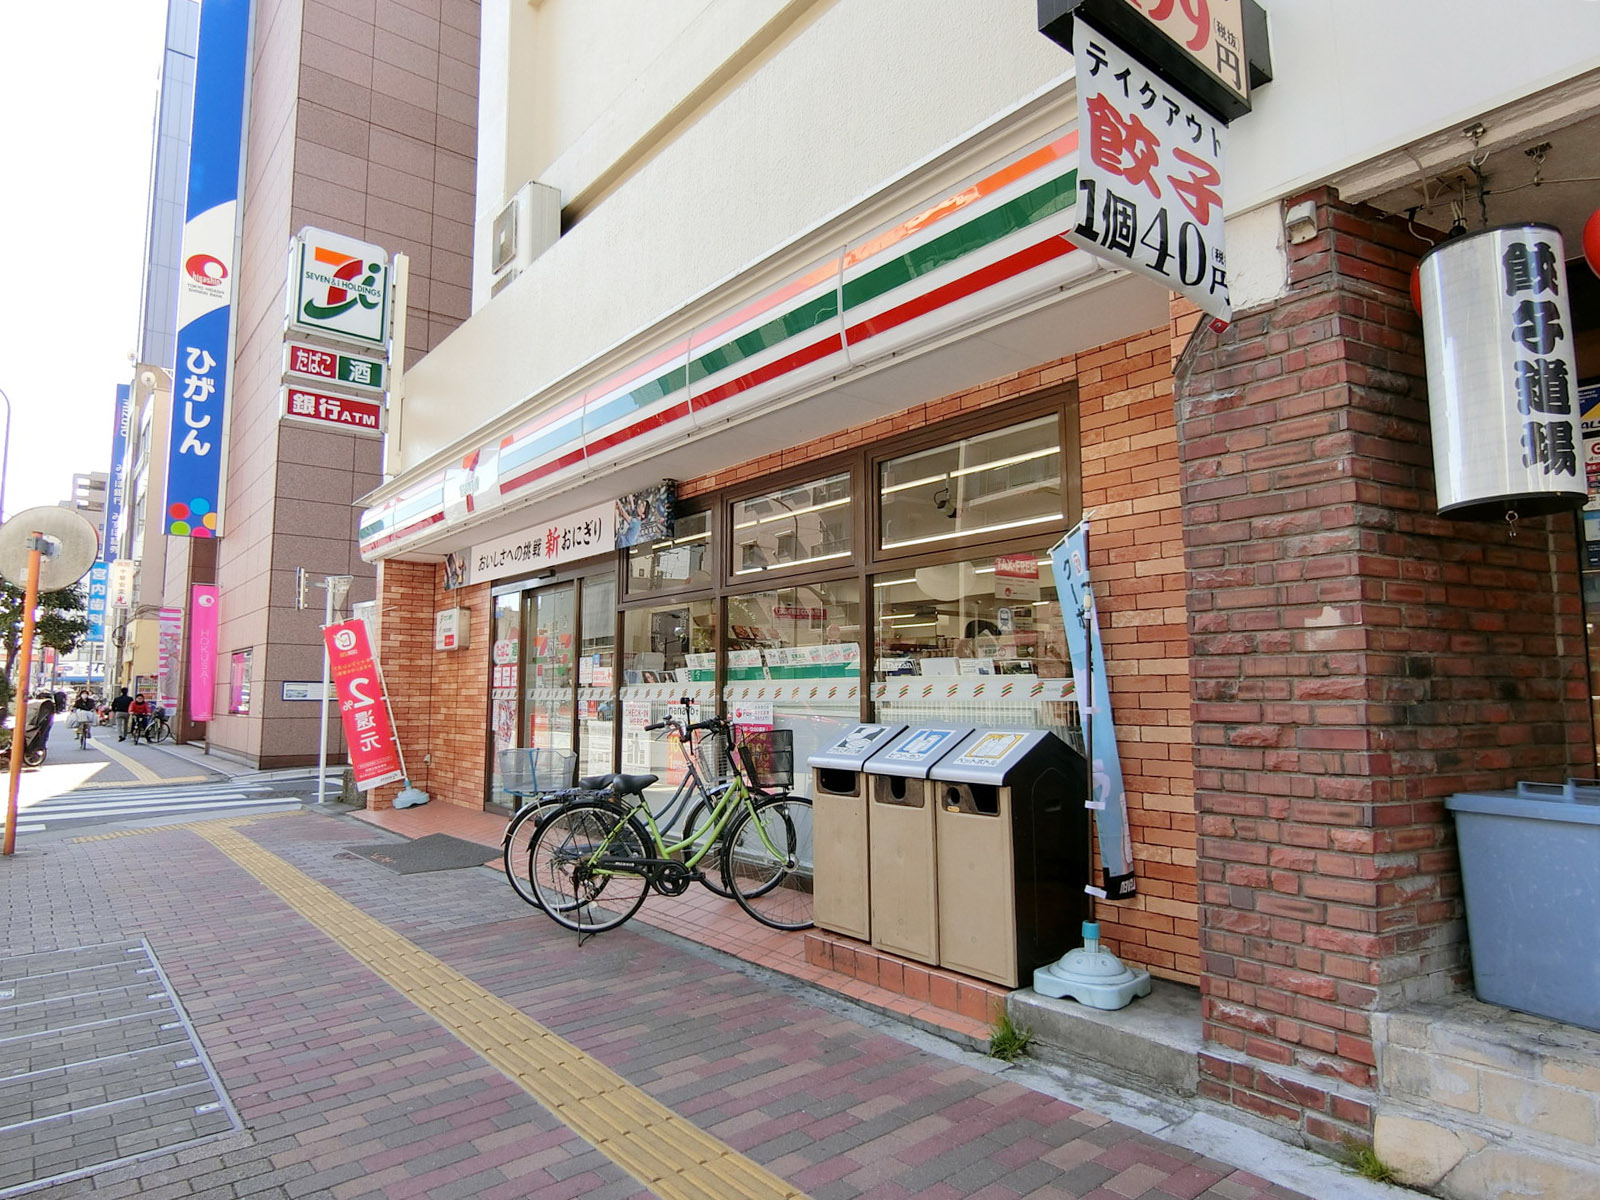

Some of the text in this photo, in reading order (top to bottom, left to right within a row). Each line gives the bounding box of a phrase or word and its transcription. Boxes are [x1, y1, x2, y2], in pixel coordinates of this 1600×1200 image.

[1086, 41, 1221, 158] テイクアウト
[1086, 92, 1224, 226] 餃子
[341, 281, 382, 298] HOLDINGS
[296, 349, 372, 384] たばこ 酒
[1502, 242, 1577, 477] 餃子道場
[179, 346, 217, 456] ひがしん
[478, 537, 543, 572] おいしさへの挑戦
[996, 557, 1038, 574] TAX-FREE
